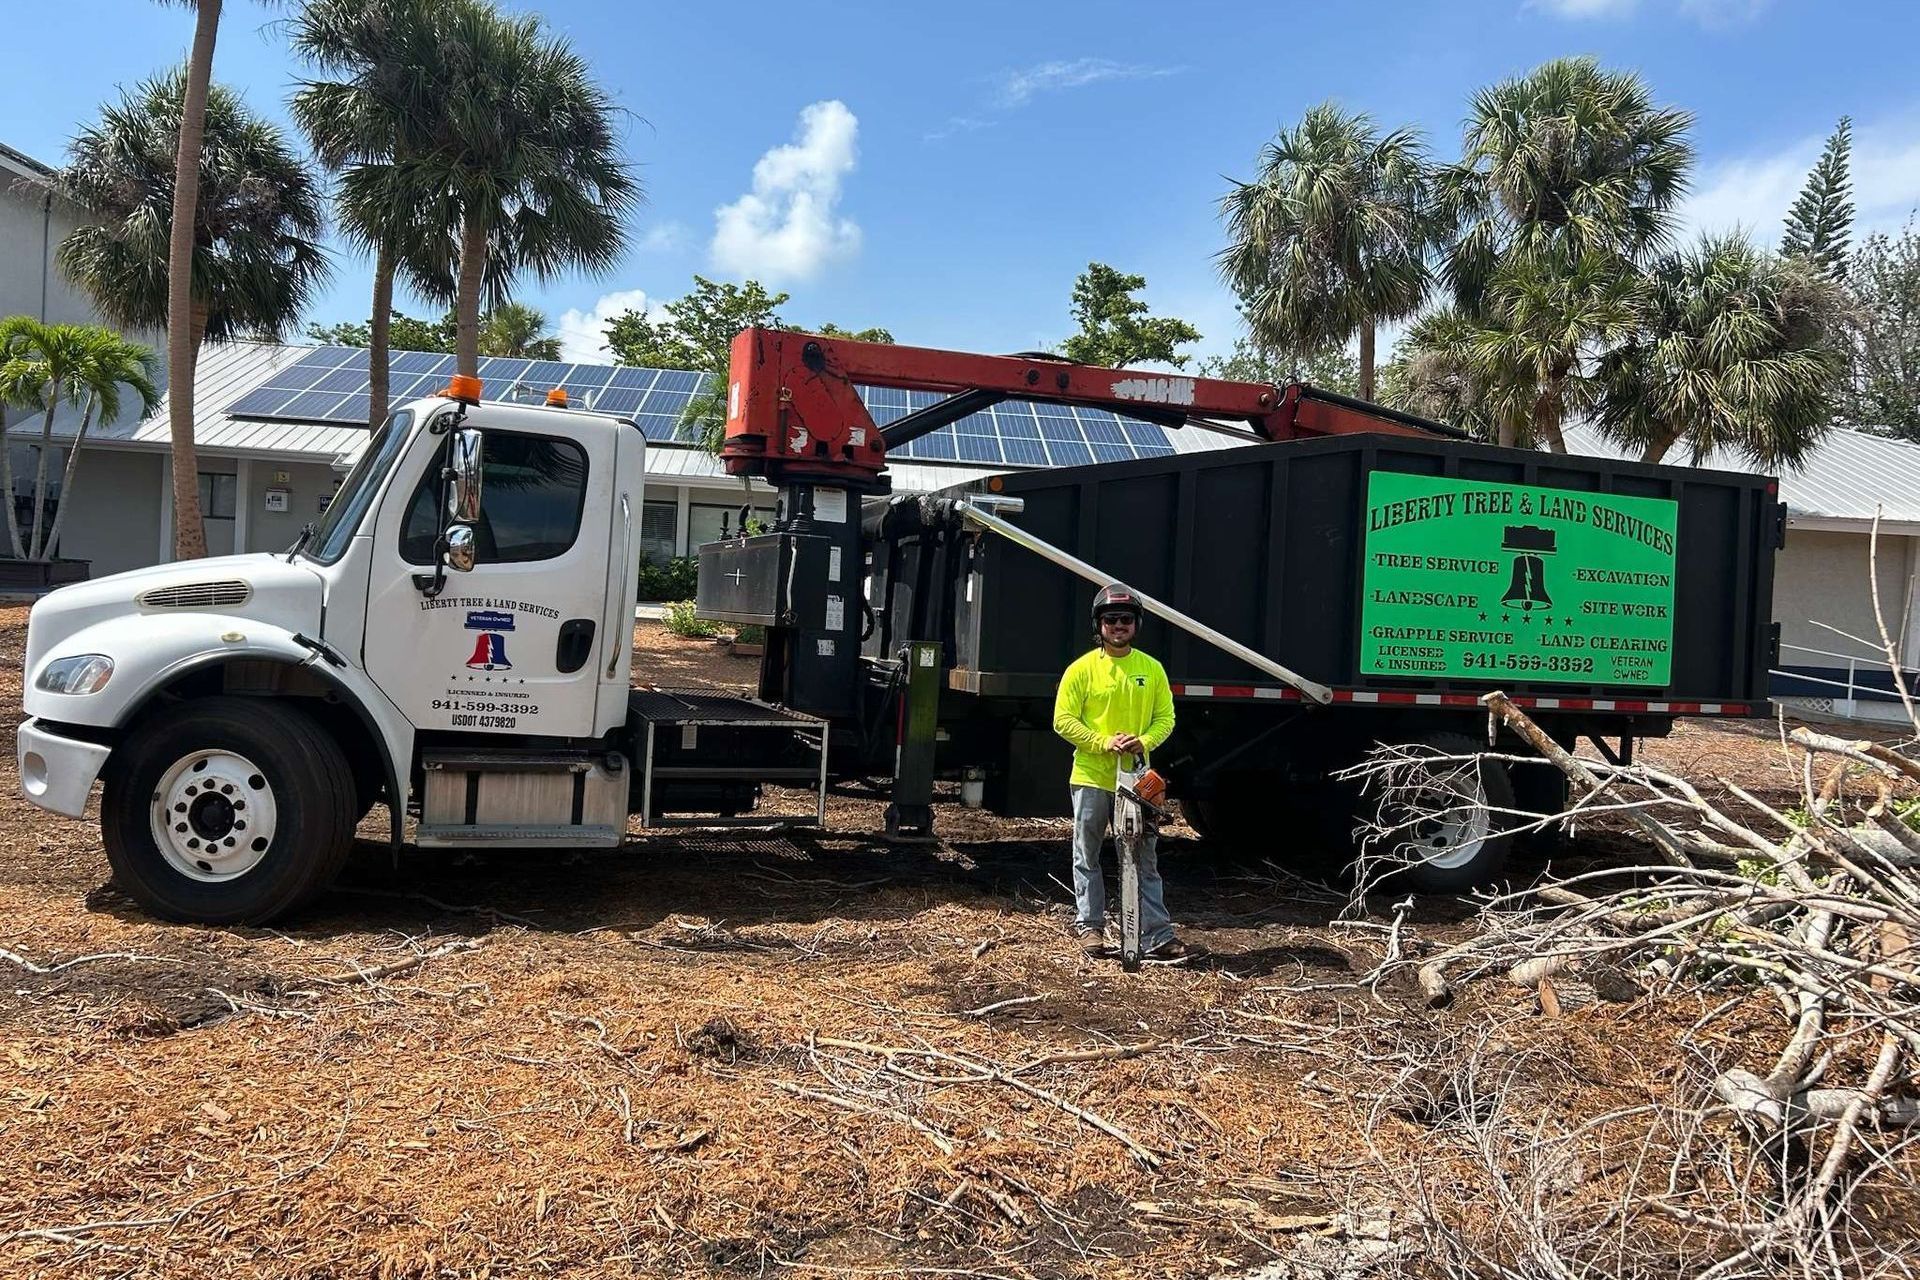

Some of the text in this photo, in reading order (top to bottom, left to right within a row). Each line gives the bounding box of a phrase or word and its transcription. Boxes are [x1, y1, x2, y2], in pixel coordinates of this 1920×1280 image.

[1370, 491, 1673, 556] LIBERTY TREE & LAND SERVICES
[1426, 556, 1499, 574] SERVICE
[421, 598, 559, 619] LIBERTY TREE & LAND SERVICES
[1622, 605, 1667, 618] WORK
[1449, 630, 1514, 645] SERVICE
[1590, 636, 1667, 652] CLEARING
[1378, 645, 1444, 658] LICENSED
[1375, 659, 1447, 671] & INSURED
[1463, 652, 1593, 673] 941-599-3392
[1611, 656, 1653, 668] VETERAN
[1614, 669, 1648, 680] OWNED
[448, 689, 486, 697] LICENSED
[432, 700, 539, 714] 941-599-3392
[452, 714, 516, 728] USDOT 4379820
